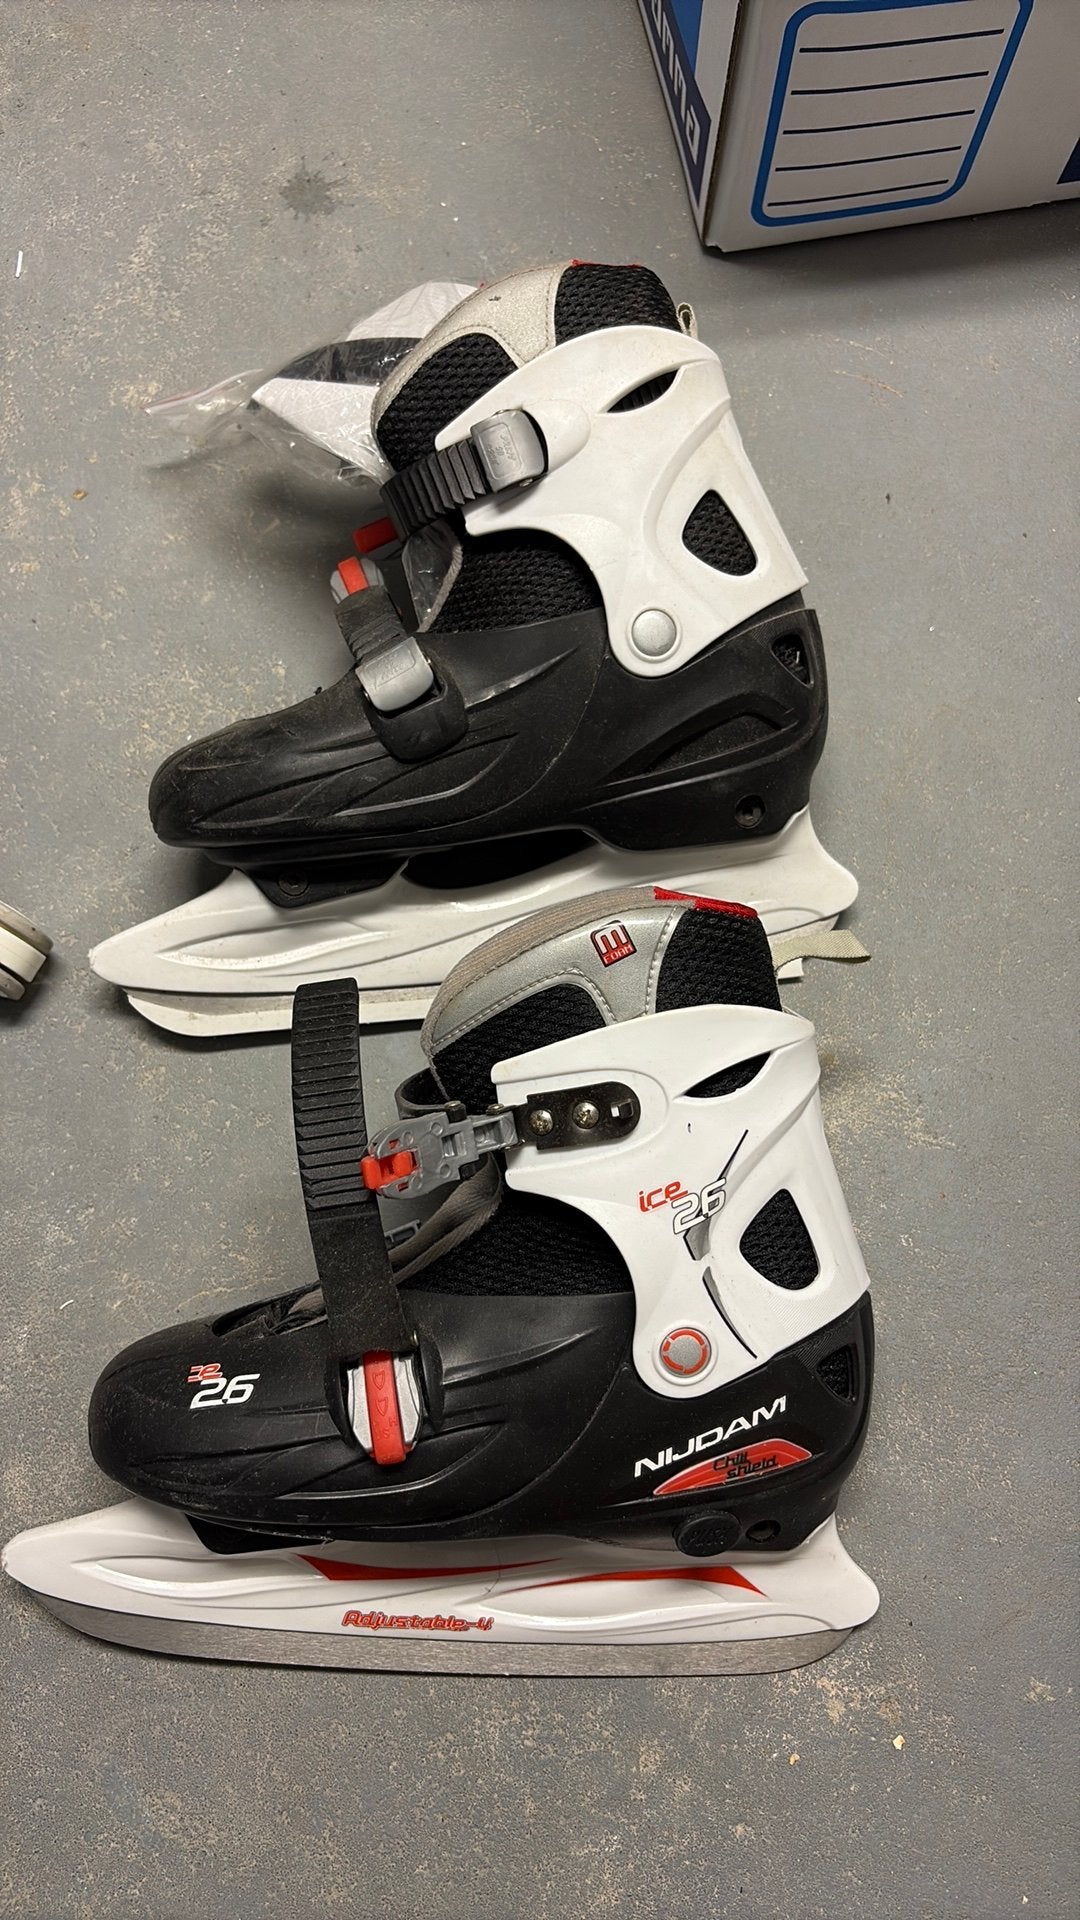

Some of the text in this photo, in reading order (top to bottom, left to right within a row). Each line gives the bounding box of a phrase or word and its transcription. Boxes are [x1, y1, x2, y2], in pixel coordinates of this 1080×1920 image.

[603, 945, 634, 965] FOAM
[638, 1181, 689, 1213] ice
[633, 1394, 787, 1479] NIJDAM
[713, 1451, 749, 1471] Chill
[726, 1455, 779, 1479] shield
